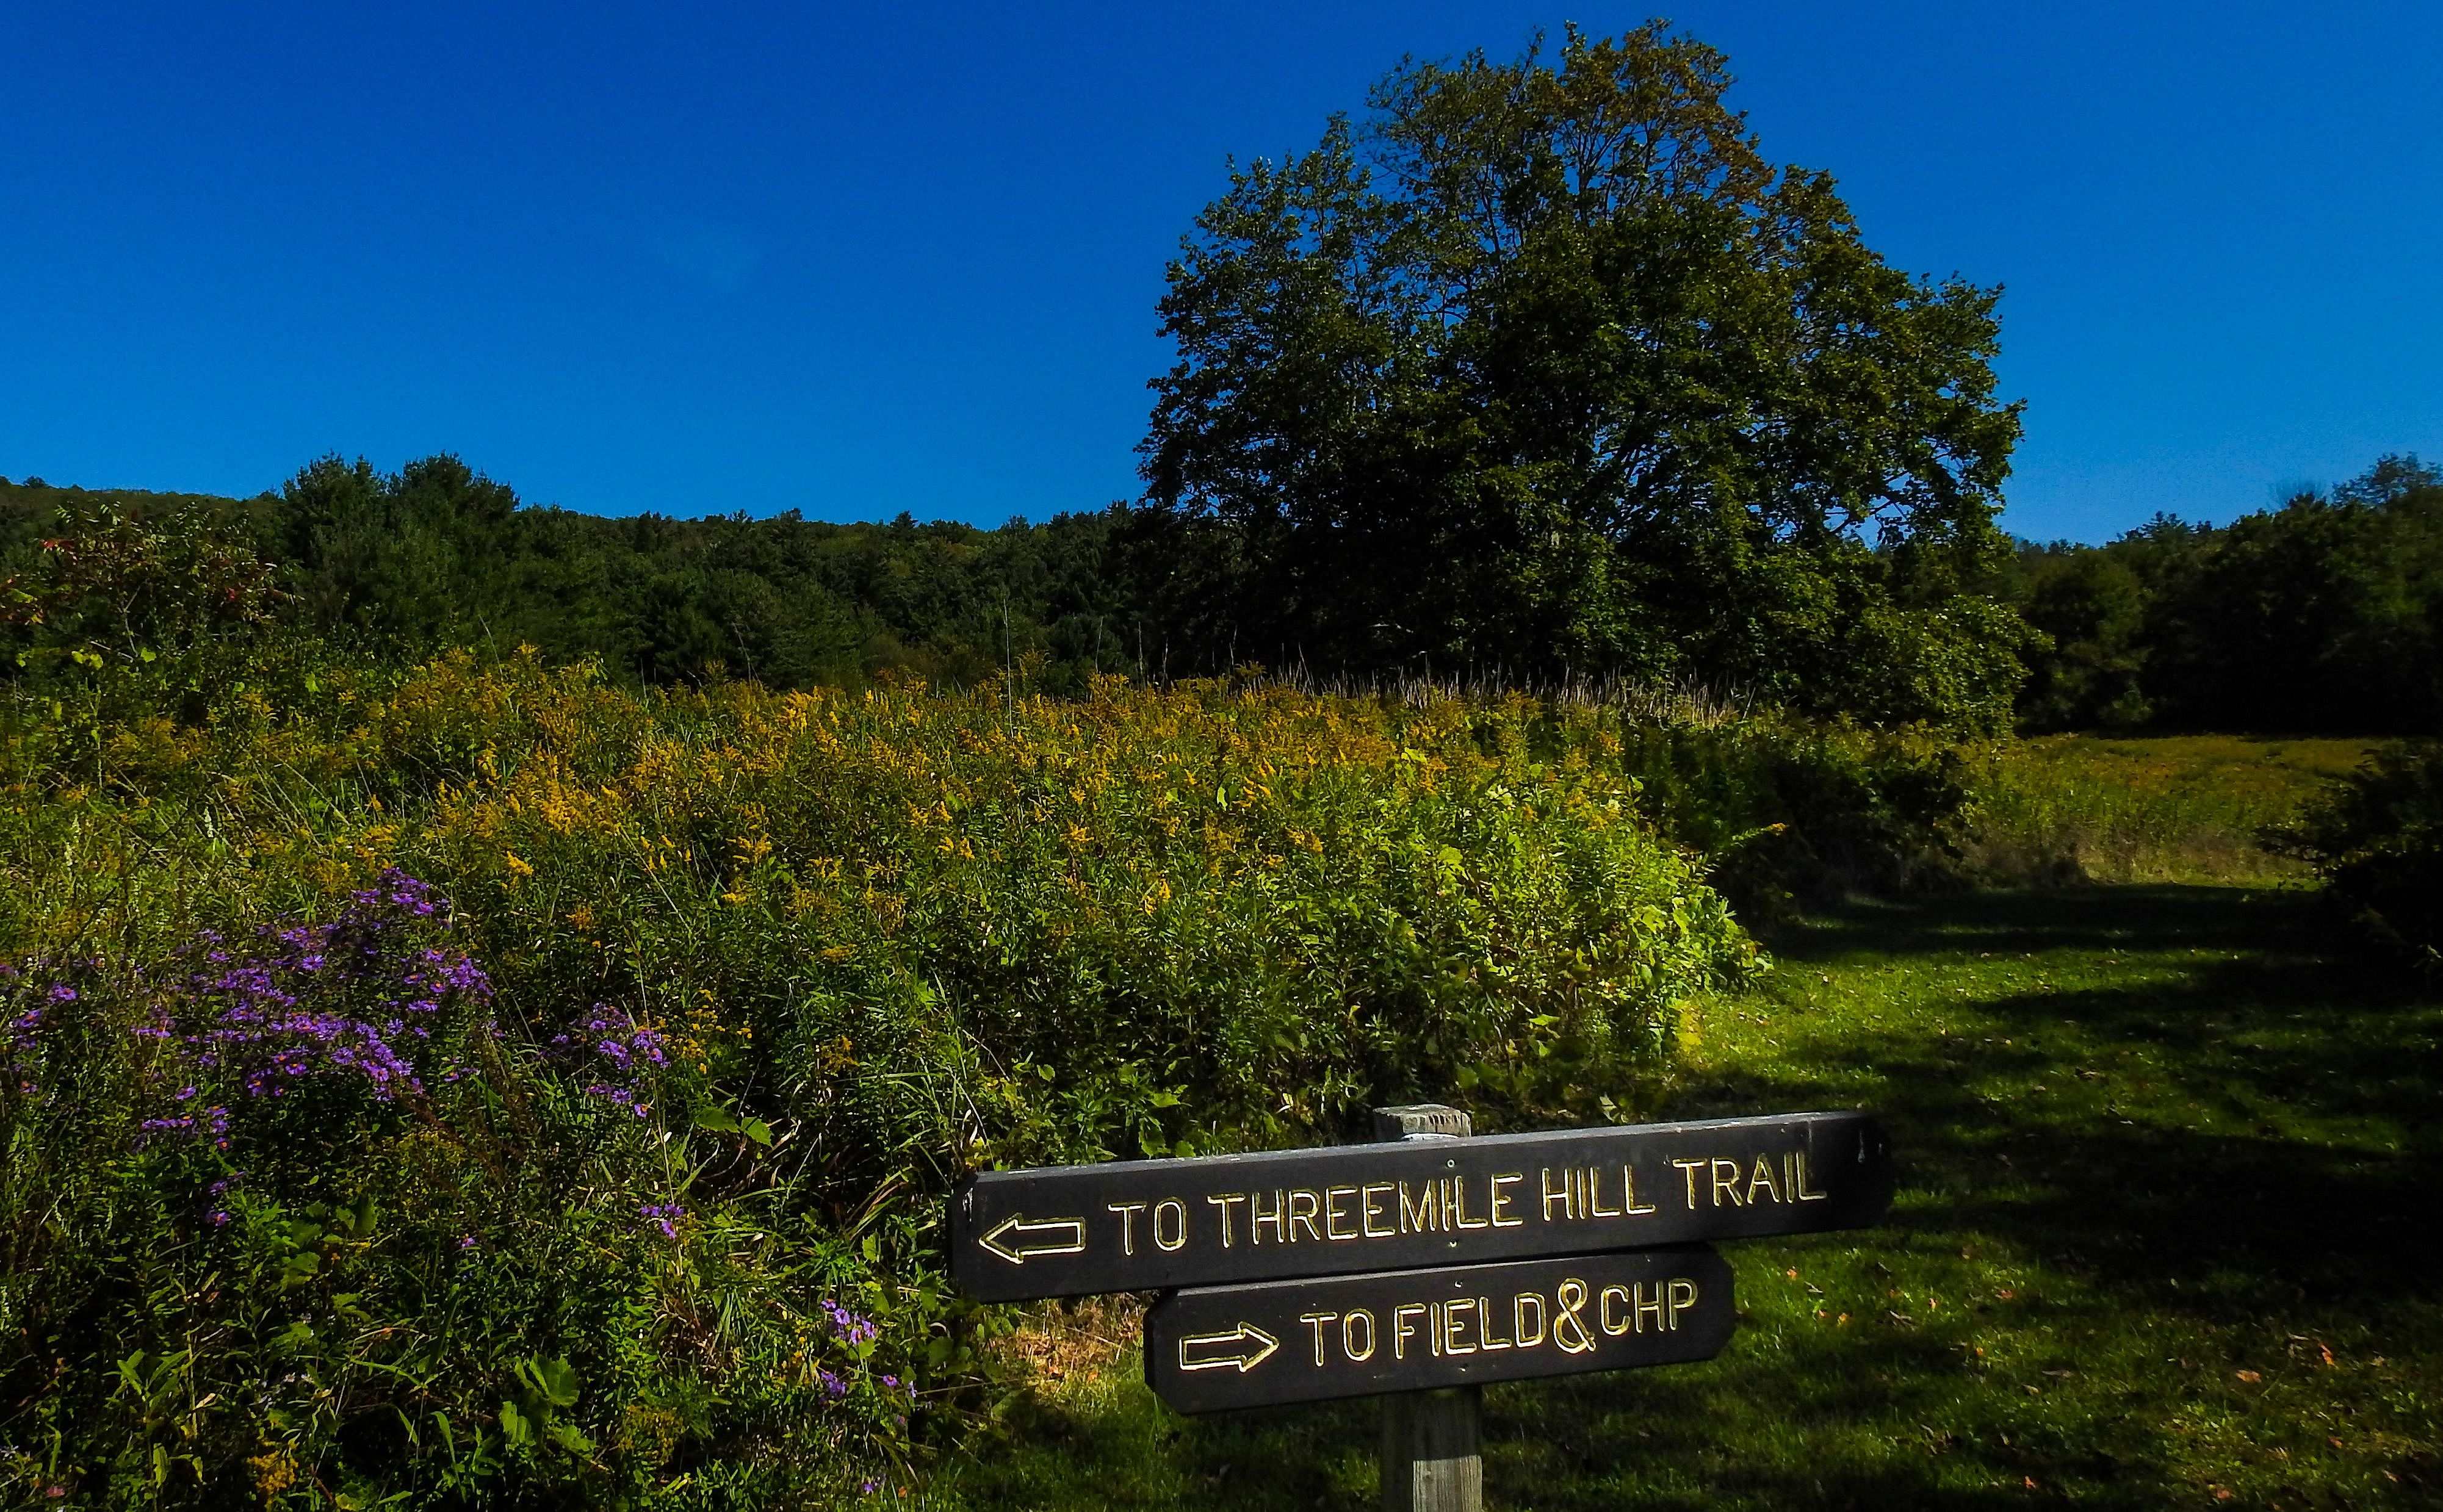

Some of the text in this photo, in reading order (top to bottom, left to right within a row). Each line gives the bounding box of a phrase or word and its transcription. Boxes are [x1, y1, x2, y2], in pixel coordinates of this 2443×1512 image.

[1108, 1150, 1828, 1256] TO THREEMILE HILL TRAIL
[1299, 1308, 1376, 1367] TO
